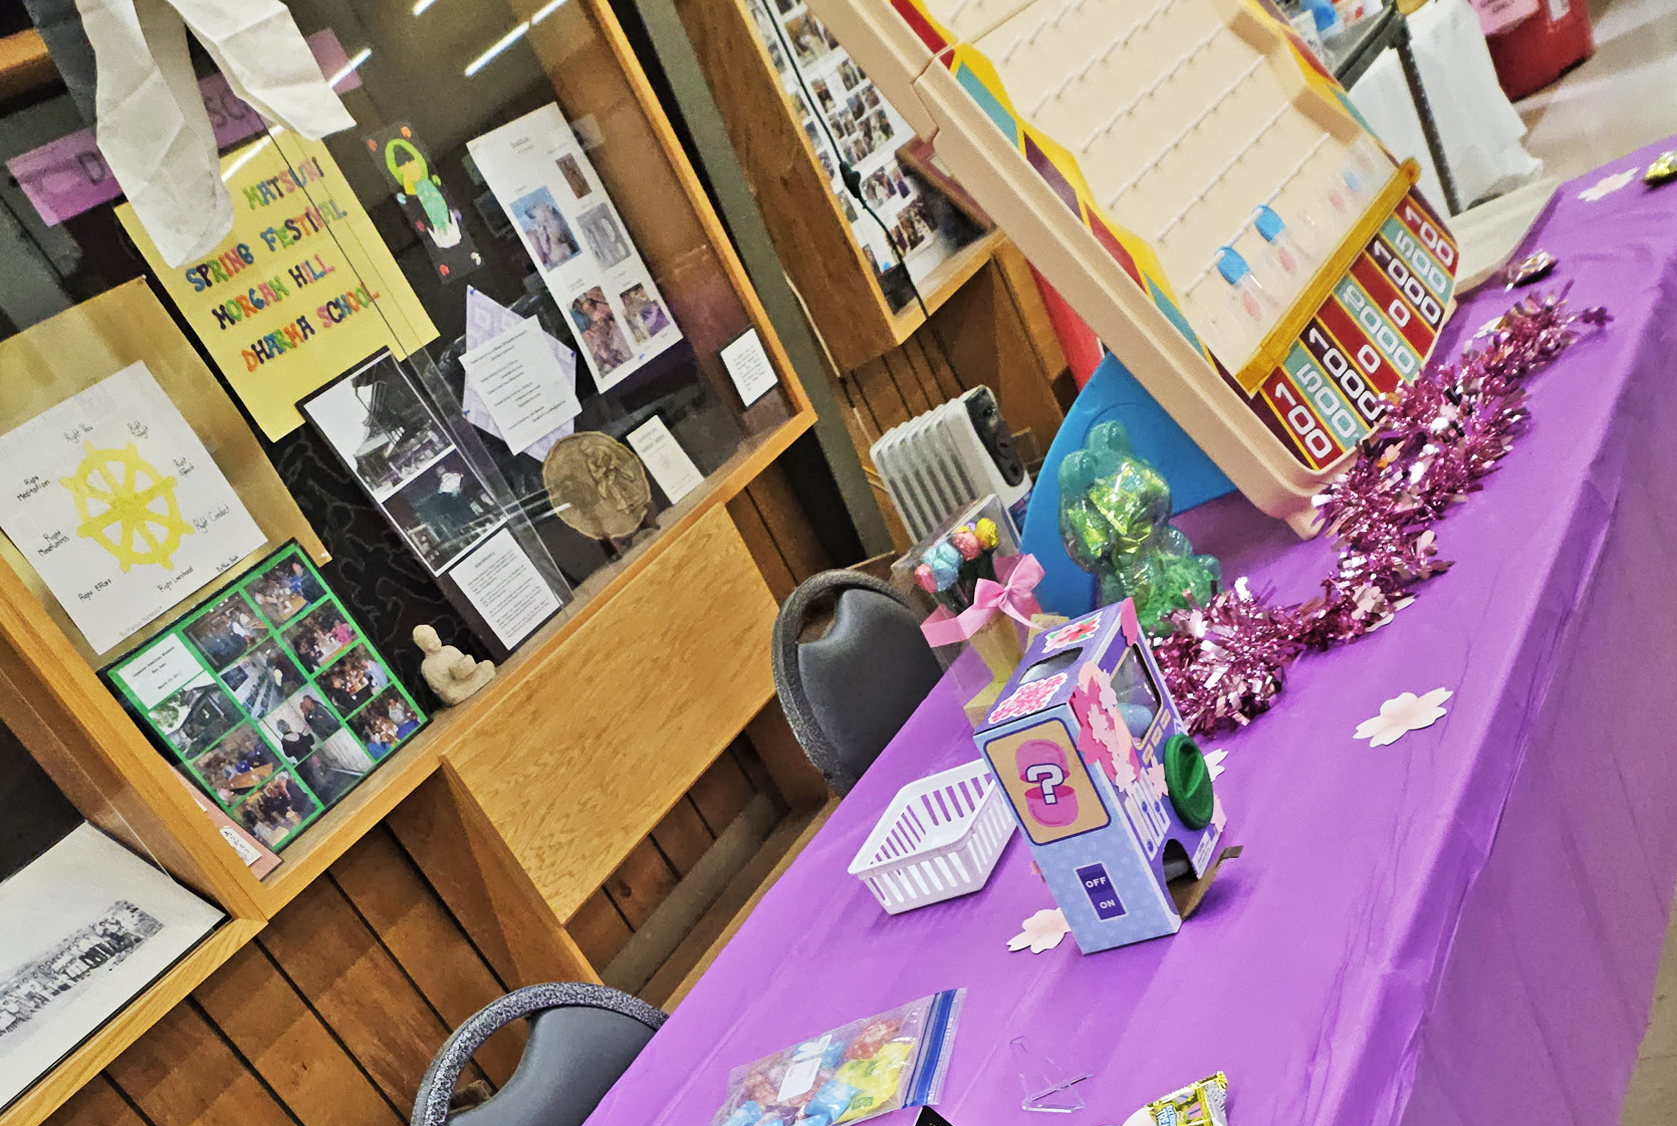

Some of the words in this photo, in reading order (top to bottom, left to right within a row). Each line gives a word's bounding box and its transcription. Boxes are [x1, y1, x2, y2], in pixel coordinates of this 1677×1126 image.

[243, 157, 324, 210] MATSURI
[185, 243, 254, 293] SPRING
[259, 199, 348, 252] FESTIVAL
[1395, 229, 1448, 294] 500
[1405, 204, 1455, 267] 100
[212, 276, 291, 330] MORGAN
[288, 253, 335, 289] HILL
[1373, 239, 1441, 325] 1000
[241, 316, 316, 373] DHARMA
[316, 282, 382, 329] SCHOOL
[1296, 362, 1358, 439] 500
[1308, 327, 1384, 421] 1000
[1274, 382, 1333, 460] 100
[1085, 875, 1107, 889] OFF
[1099, 898, 1116, 909] ON
